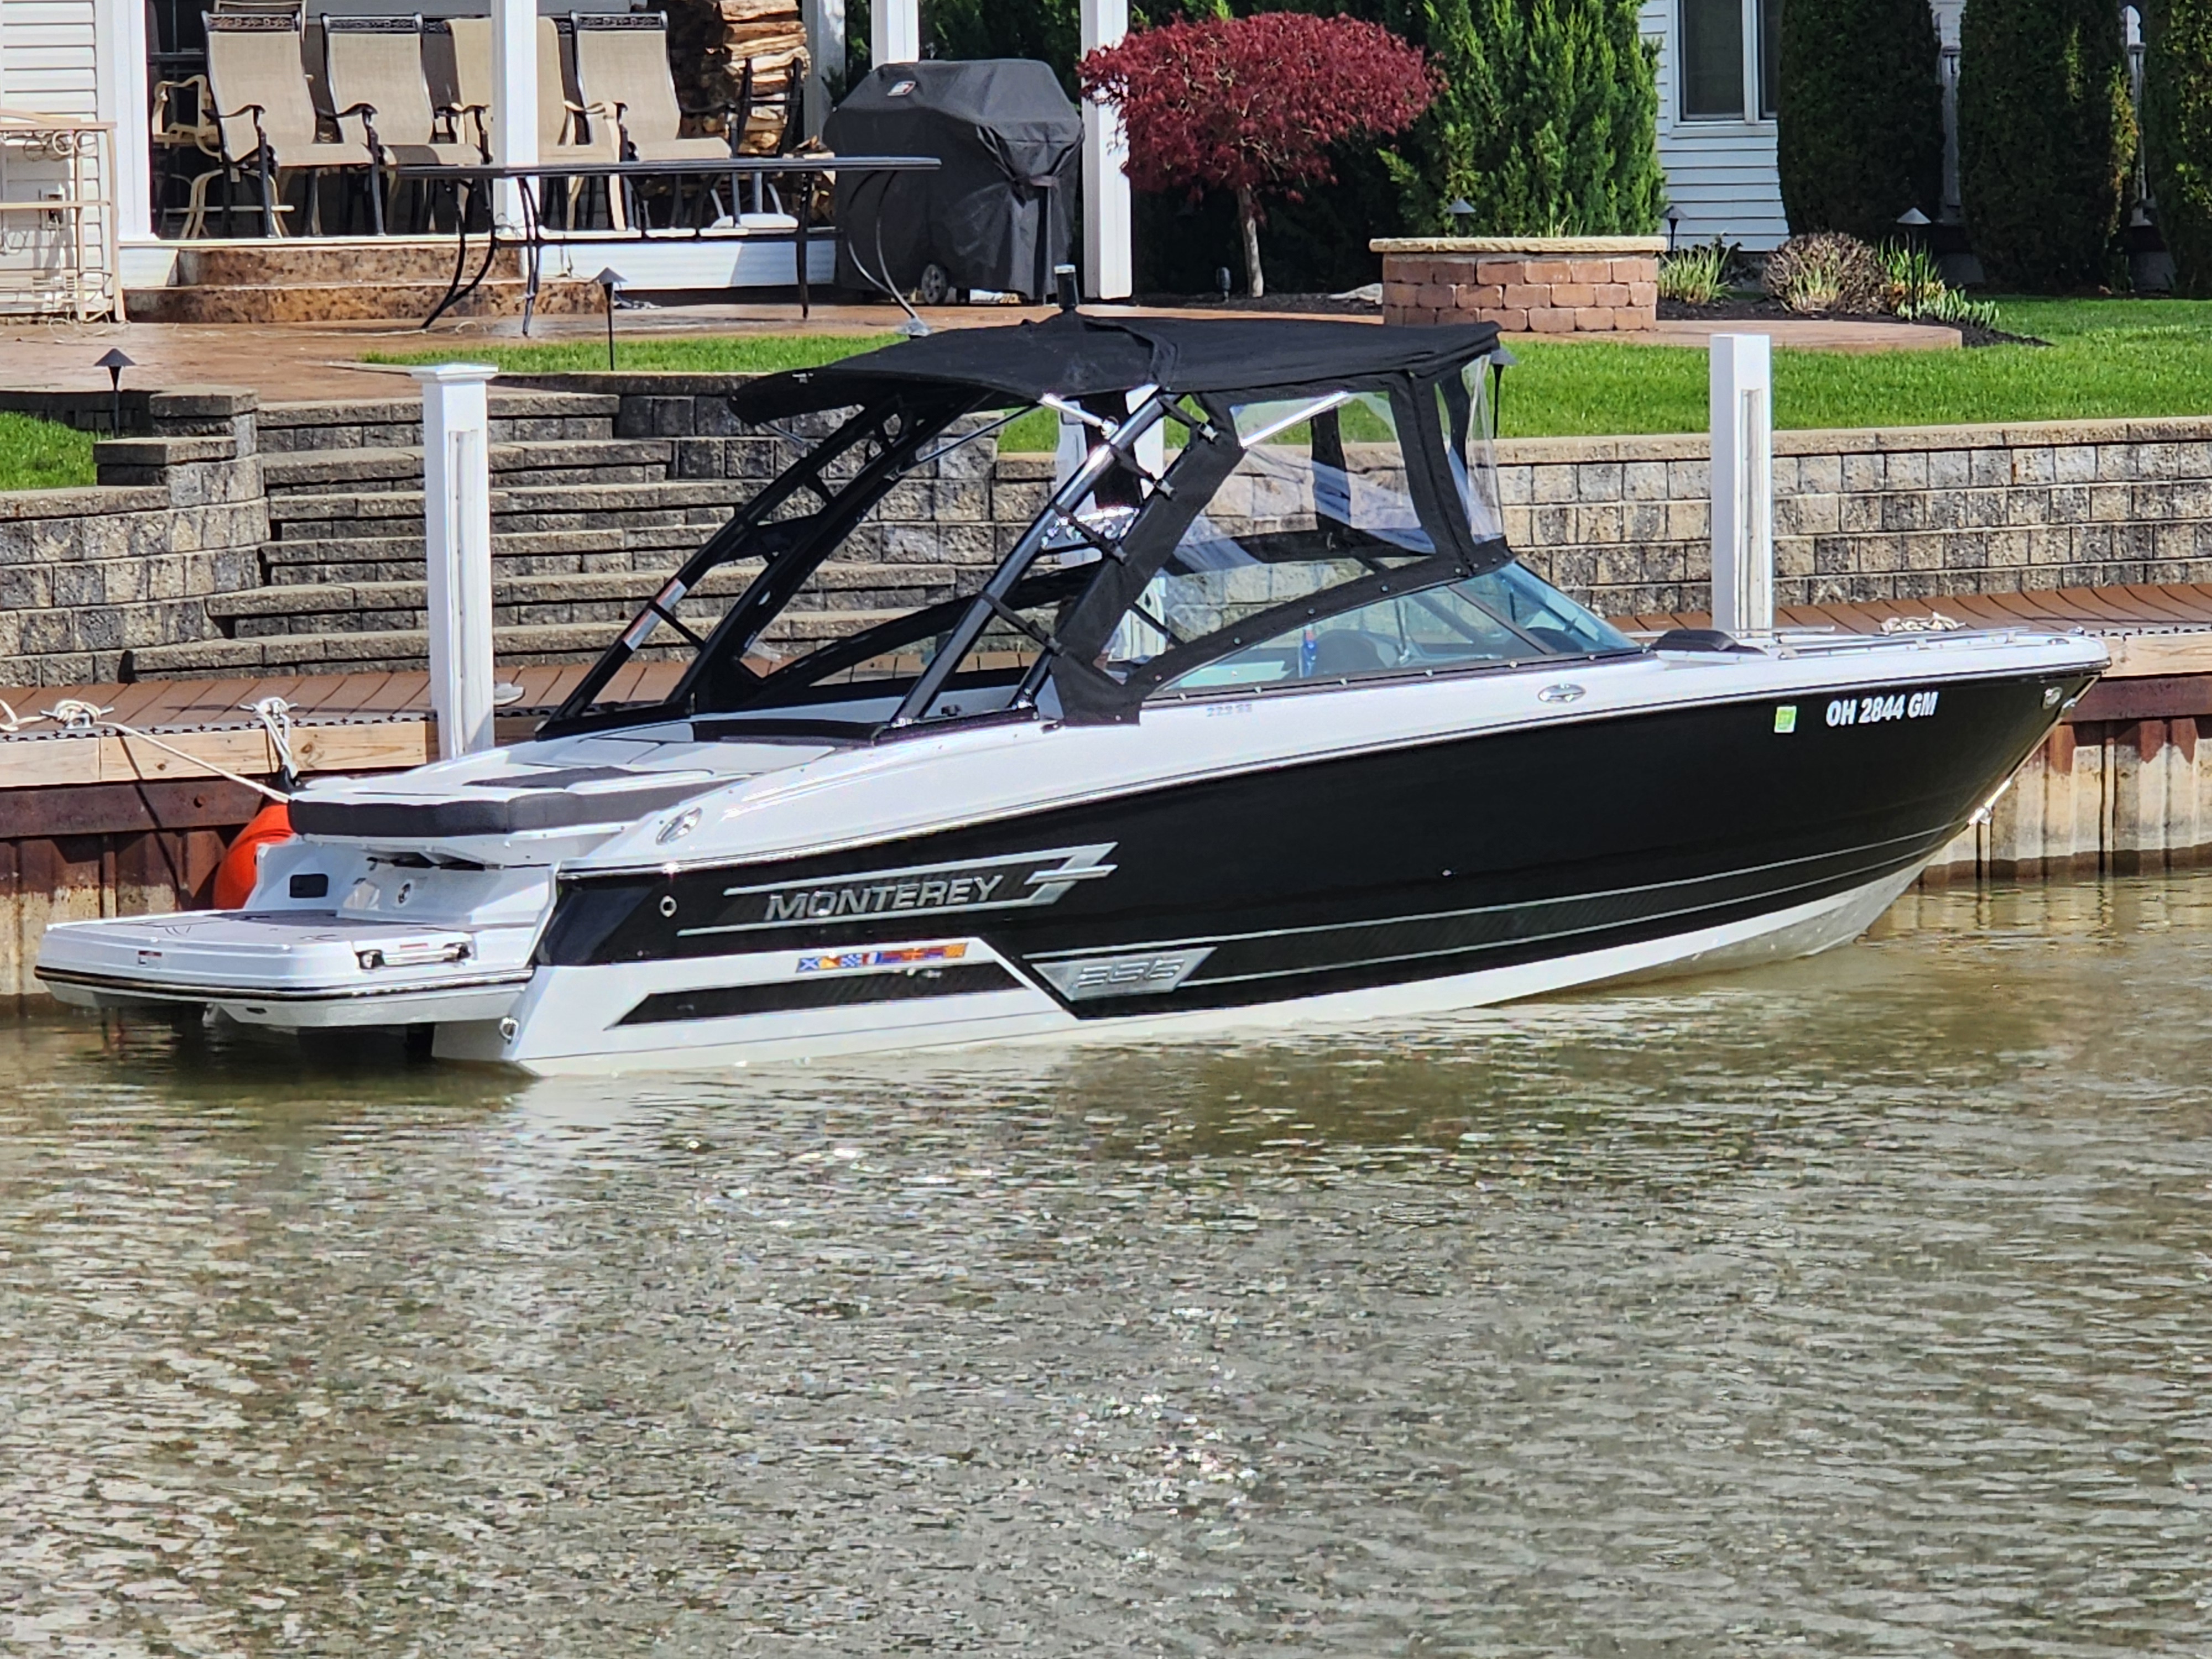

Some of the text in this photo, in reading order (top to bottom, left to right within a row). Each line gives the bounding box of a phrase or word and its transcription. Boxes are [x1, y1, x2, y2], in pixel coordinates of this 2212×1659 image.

[1825, 691, 1939, 727] OH 2844 GM
[764, 875, 1003, 920] MONTEREY
